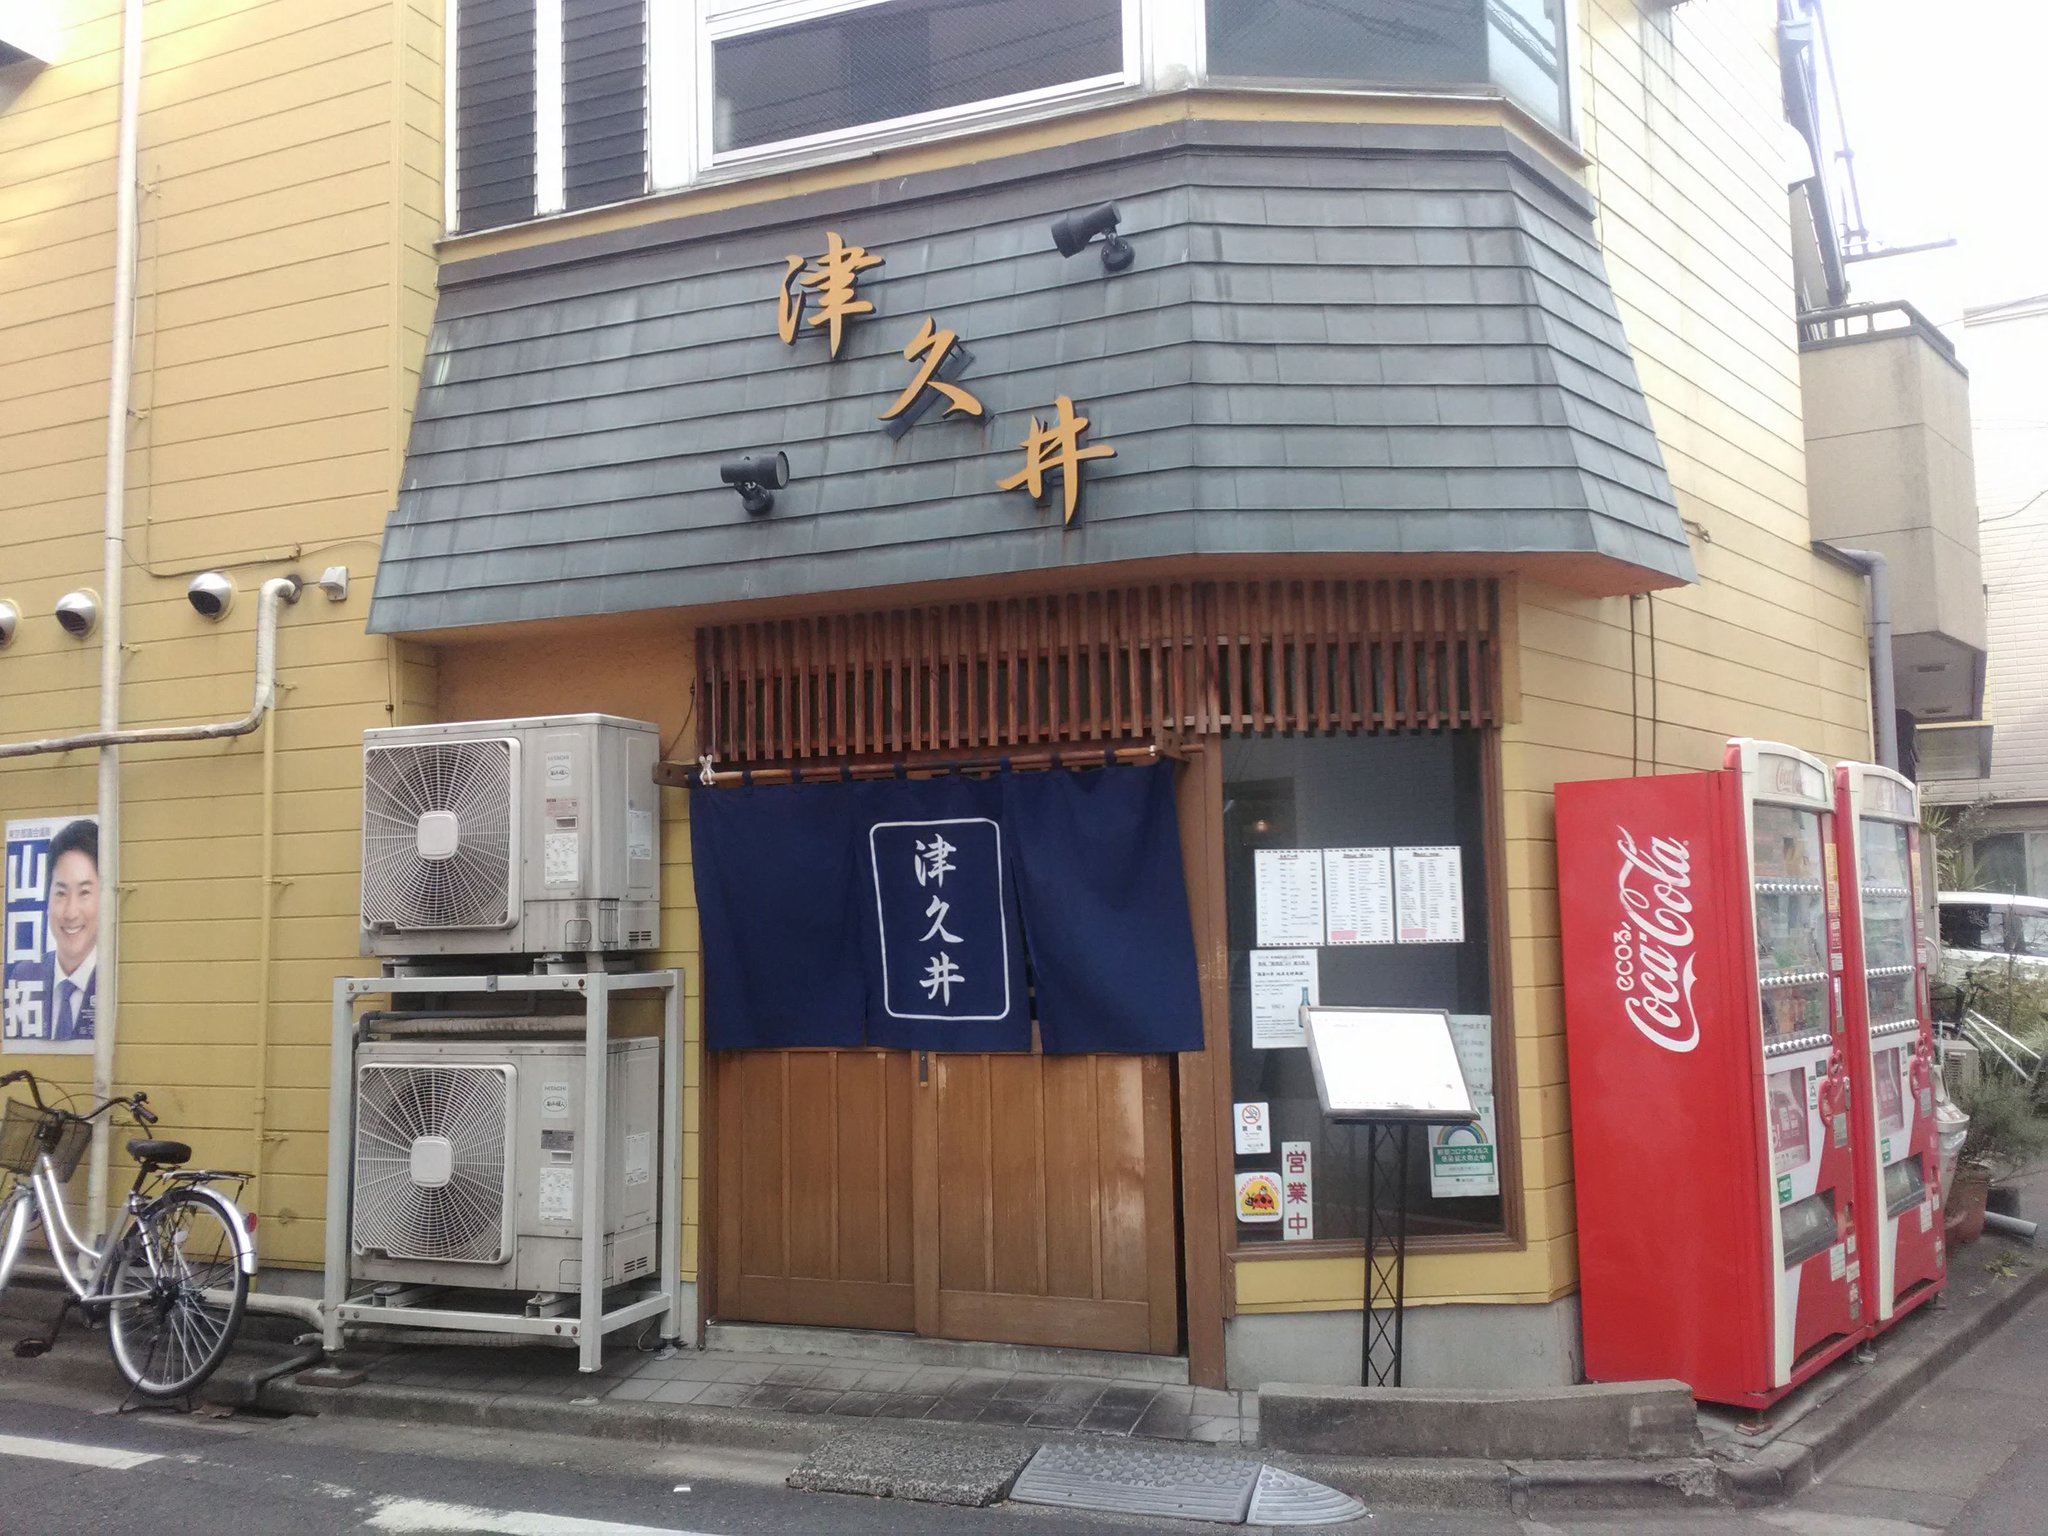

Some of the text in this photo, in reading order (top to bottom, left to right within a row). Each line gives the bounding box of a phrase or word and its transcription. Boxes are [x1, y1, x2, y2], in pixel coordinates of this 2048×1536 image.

[777, 231, 1118, 525] 津久井
[4, 844, 48, 1038] 山口拓
[913, 833, 966, 1007] 津久井
[1616, 824, 1701, 1053] Coca-Cola
[1286, 1150, 1308, 1236] 営業中
